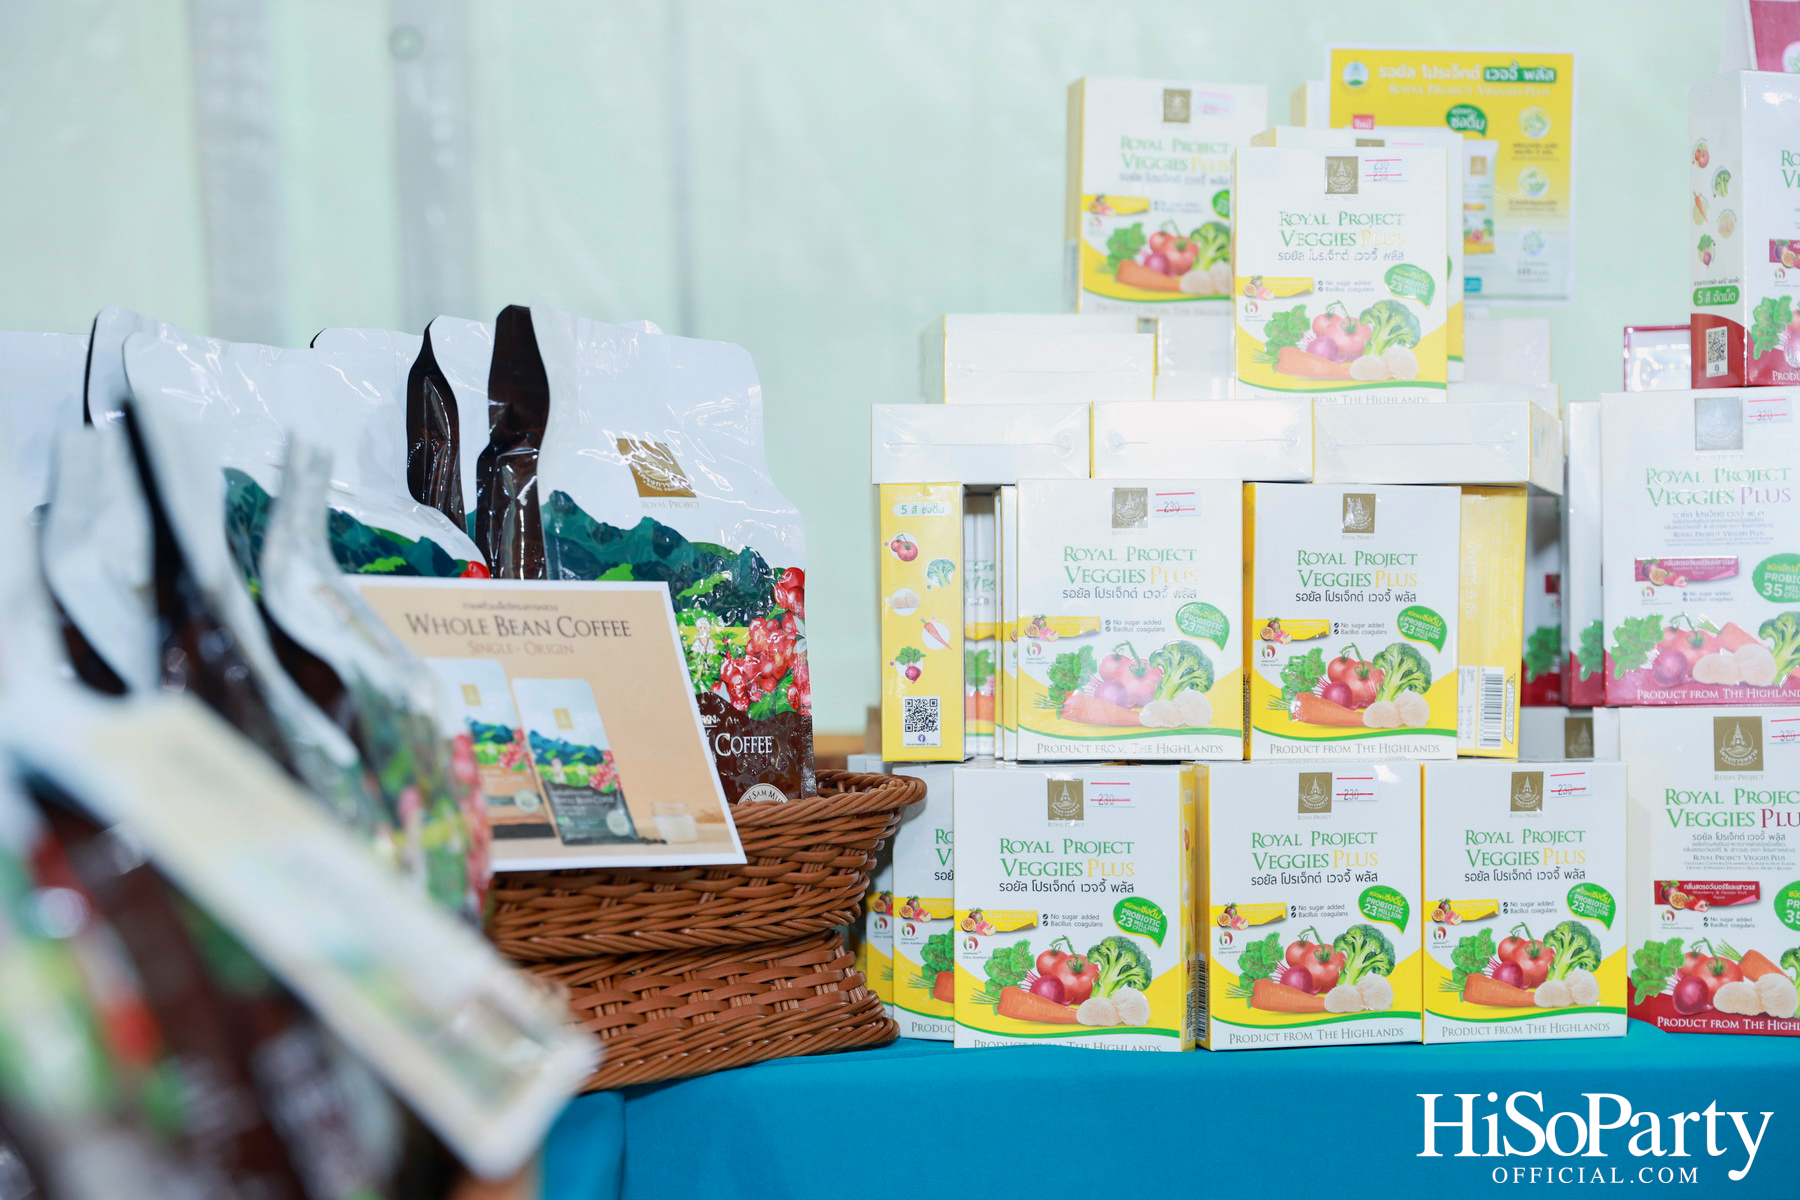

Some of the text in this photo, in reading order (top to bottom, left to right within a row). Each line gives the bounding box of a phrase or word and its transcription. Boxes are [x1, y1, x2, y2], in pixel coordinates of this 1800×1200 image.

[1279, 211, 1405, 228] ROYAL PROJECT
[1279, 229, 1405, 247] VEGGIES PLUS
[1646, 467, 1791, 486] ROYAL PROJECT
[1647, 486, 1791, 507] VEGGIES PLUS
[901, 504, 908, 514] 5
[1164, 501, 1180, 513] 230
[1063, 546, 1197, 564] ROYAL PROJECT
[1297, 550, 1418, 568] ROYAL PROJECT
[1063, 565, 1198, 584] VEGGIES PLUS
[1297, 569, 1418, 588] VEGGIES PLUS
[1295, 588, 1416, 602] รอยัล โปรเจ็กต์ เวจจี้ พลัส
[1762, 582, 1783, 597] 35
[405, 613, 632, 638] WHOLE BEAN COFFEE
[1401, 623, 1415, 635] 23
[1406, 616, 1441, 634] PROBIOTIC
[1637, 688, 1800, 699] PRODUCT FROM THE HIGHLAN
[1780, 730, 1796, 741] 320
[715, 733, 773, 756] COFFEE
[1270, 743, 1440, 755] PRODUCT FROM THE HIGHLANDS
[1343, 789, 1359, 801] 230
[1557, 784, 1573, 796] 230
[1665, 788, 1800, 807] ROYAL PROJEC
[1098, 793, 1114, 806] 230
[1665, 808, 1800, 828] VEGGIES PLU
[1251, 831, 1378, 848] ROYAL PROJECT
[1465, 828, 1586, 846] ROYAL PROJECT
[1692, 832, 1712, 841] รอยัล
[1769, 832, 1786, 841] พลัส
[1000, 838, 1135, 857] ROYAL PROJECT
[1251, 850, 1379, 871] VEGGIES PLUS
[1465, 847, 1586, 868] VEGGIES PLUS
[1000, 858, 1135, 878] VEGGIES PLUS
[1464, 866, 1585, 882] รอยัล โปรเจ็กต์ เวจจี้ พลัส
[999, 878, 1134, 893] รอยัล โปรเจ็กต์ เวจจี้ พลัส
[1251, 869, 1378, 886] รอยัล โปรเจ็กต์ เวจจี้ พลัส
[1363, 903, 1402, 919] 23 MILLION
[1366, 896, 1404, 914] PROBIOTIC
[1571, 900, 1608, 916] 23 MILLION
[1574, 894, 1610, 911] PROBIOTIC
[1118, 915, 1159, 933] 23 MILLION
[1121, 908, 1161, 927] PROBIOTIC
[911, 1021, 955, 1033] PRODUC
[1442, 1022, 1610, 1037] PRODUCT FROM THE HIGHLANDS
[1657, 1016, 1800, 1031] PRODUCT FROM THE HIGHL
[1229, 1028, 1404, 1044] PRODUCT FROM THE HIGHLANDS
